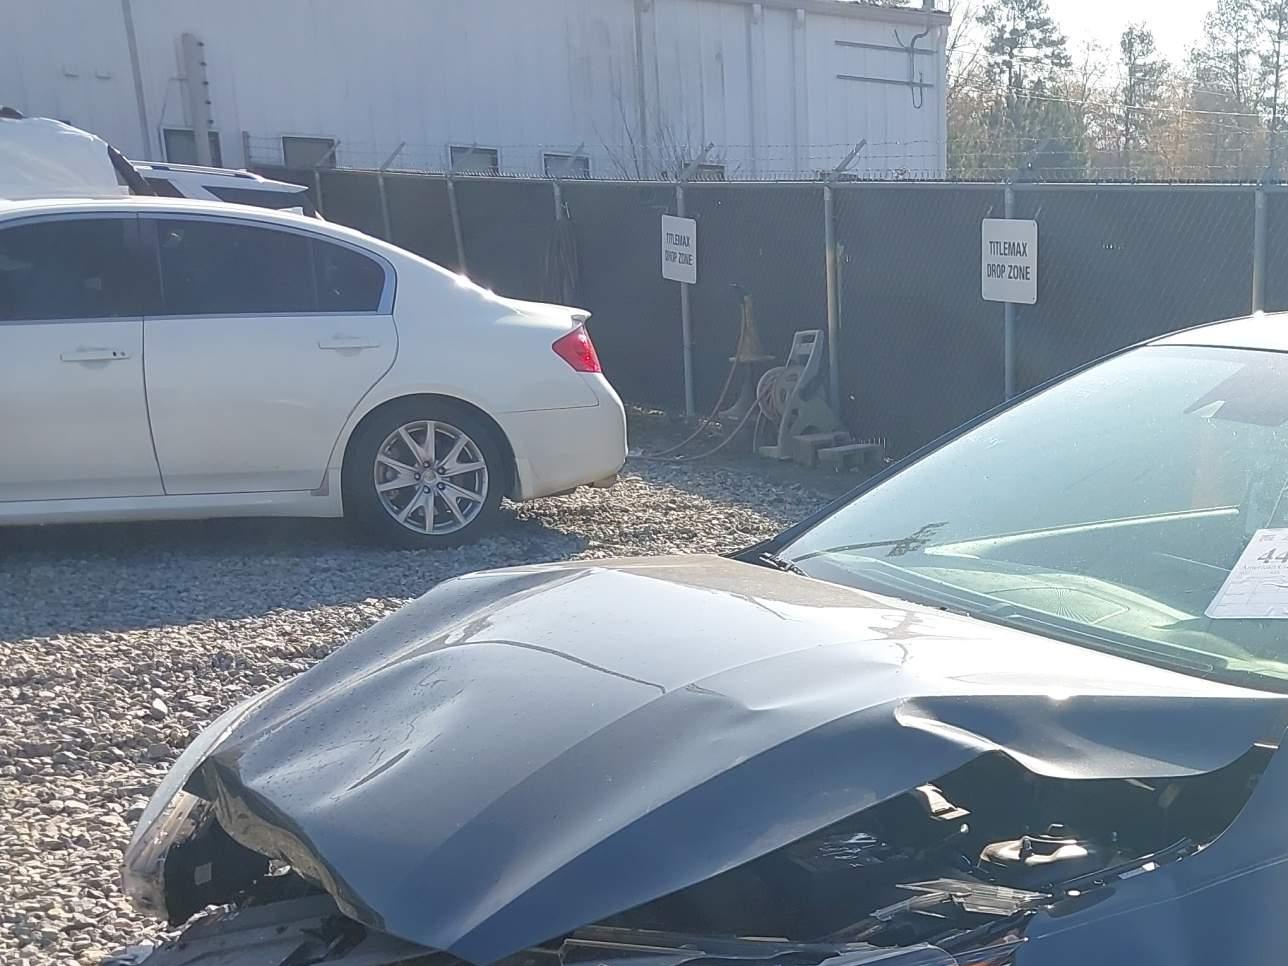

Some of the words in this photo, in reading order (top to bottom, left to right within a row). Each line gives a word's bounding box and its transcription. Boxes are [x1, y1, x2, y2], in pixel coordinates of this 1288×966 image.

[666, 232, 690, 248] TITLEMAX
[989, 241, 1028, 257] TITLEMAX
[665, 250, 678, 262] DROP
[679, 252, 694, 266] ZONE
[987, 263, 1006, 279] DROP
[1007, 264, 1031, 281] ZONE
